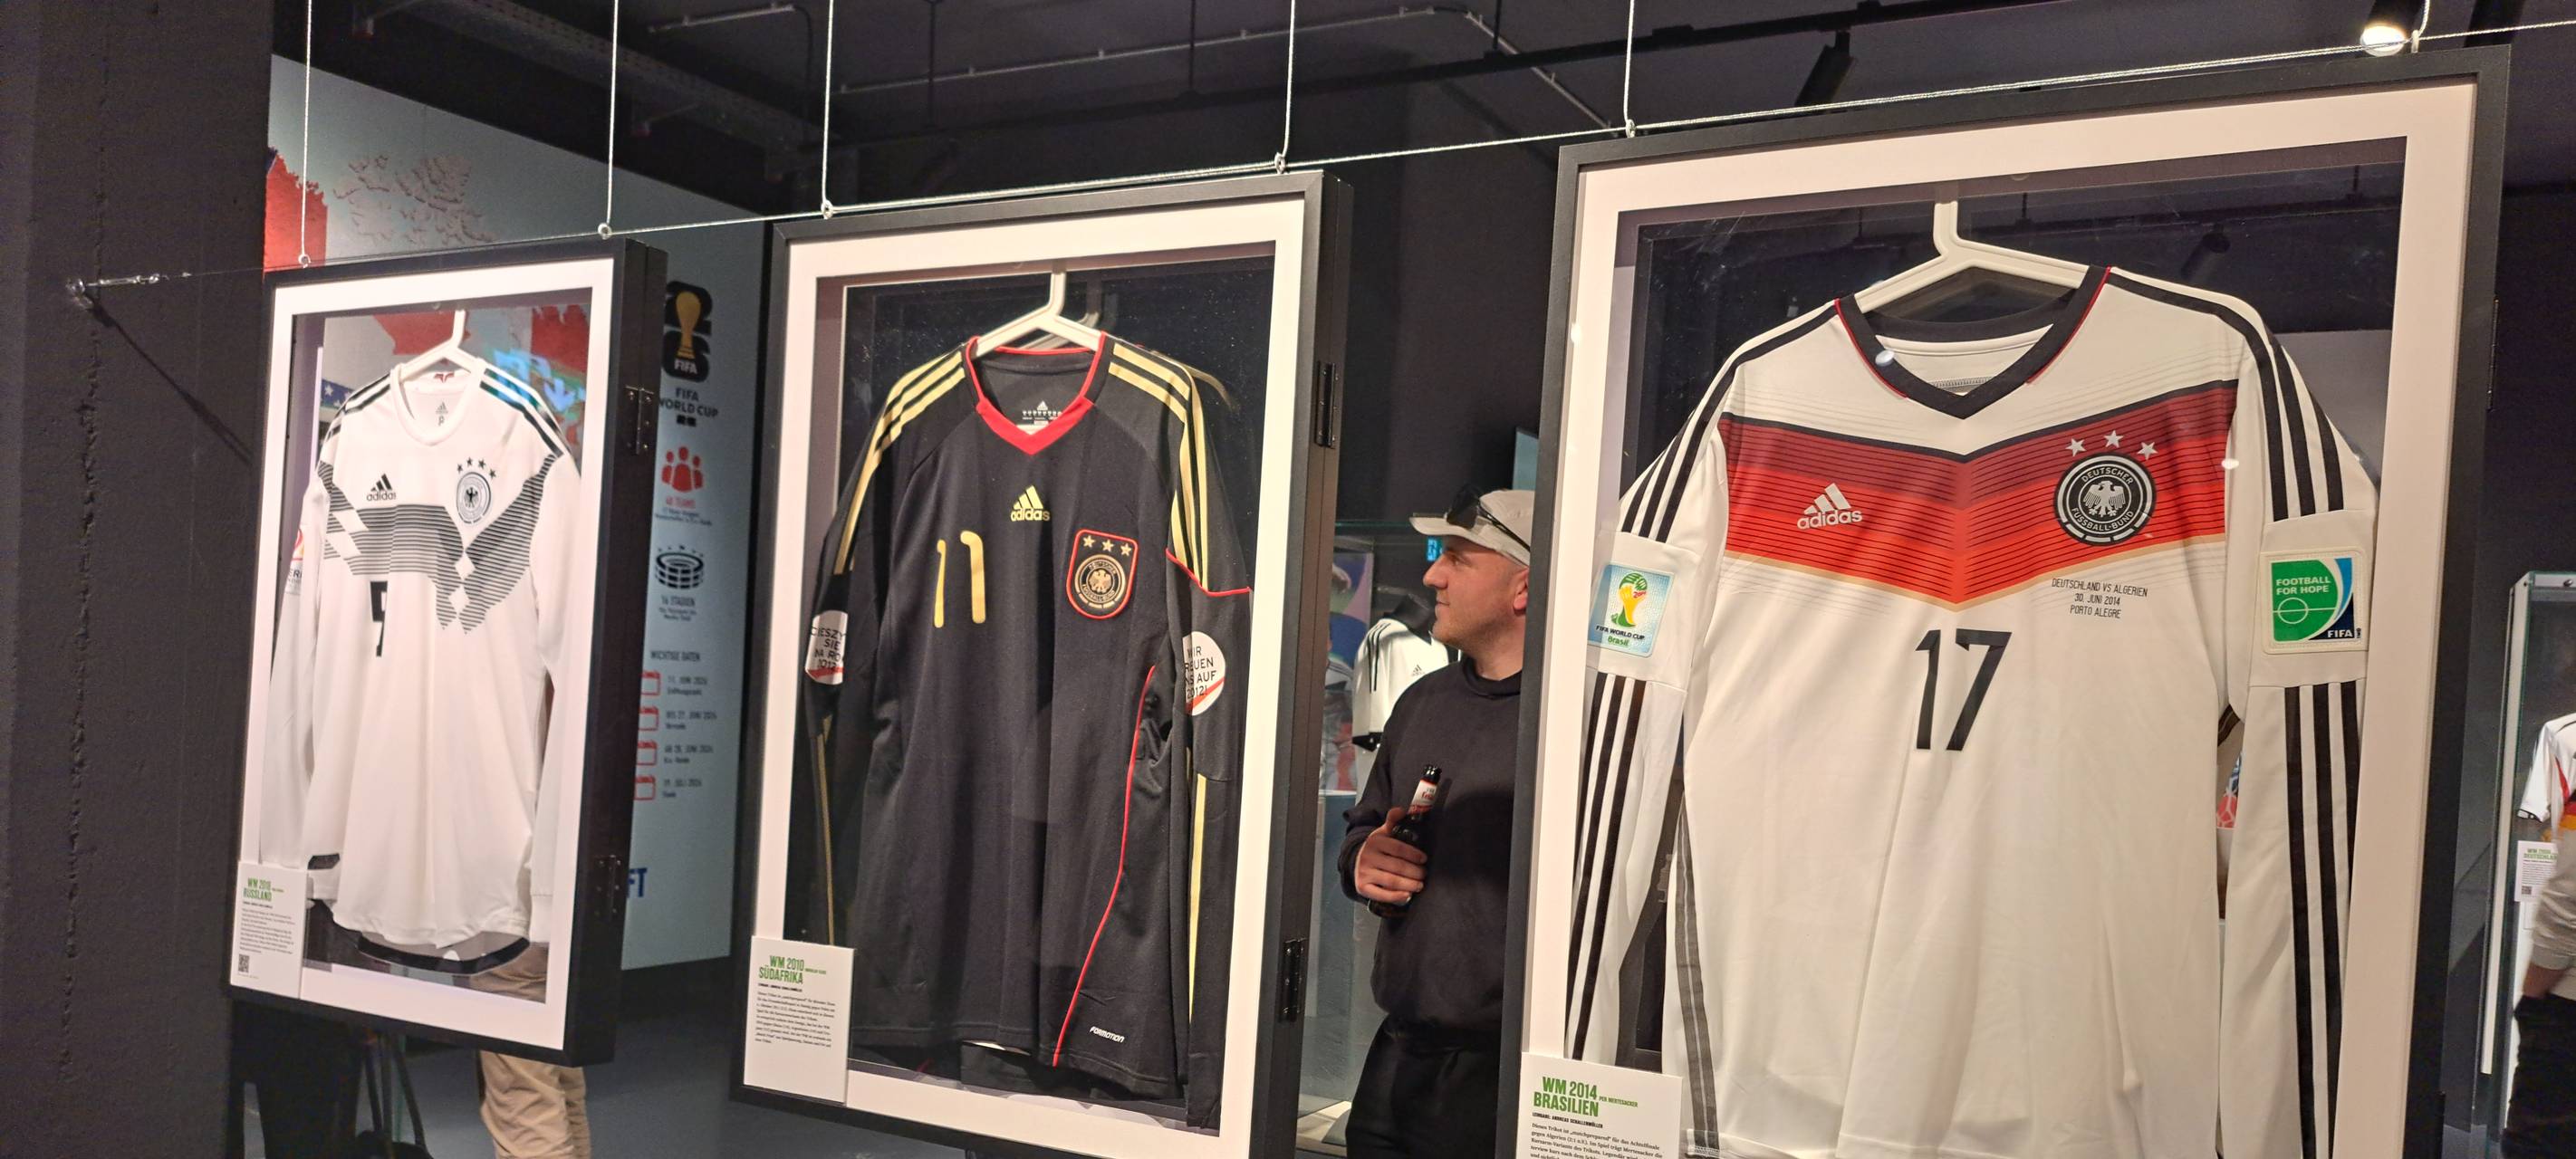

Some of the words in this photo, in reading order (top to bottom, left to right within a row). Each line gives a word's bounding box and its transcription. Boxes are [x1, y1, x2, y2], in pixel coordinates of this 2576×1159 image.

[674, 359, 697, 375] FIFA
[676, 388, 699, 402] FIFA
[697, 406, 718, 418] CUP
[2081, 467, 2134, 485] DEUTSCHER
[367, 491, 396, 502] adidas
[1011, 508, 1051, 522] adidas
[1797, 509, 1862, 529] adidas
[2052, 578, 2100, 592] DEUTSCHLAND
[2102, 583, 2111, 592] VS
[2113, 585, 2148, 598] ALGERIEN
[2275, 576, 2331, 587] FOOTBALL
[2276, 587, 2297, 596] FOR
[2301, 585, 2330, 594] HOPE
[2074, 593, 2085, 603] 30.
[2087, 594, 2102, 604] JUNI
[2104, 596, 2120, 606] 2014
[2070, 605, 2092, 616] PORTO
[2094, 608, 2121, 619] ALEGRE
[1596, 625, 1609, 633] FIFA
[1610, 628, 1632, 637] WORLD
[2327, 629, 2353, 638] FIFA
[1608, 636, 1629, 646] Brasil
[682, 651, 700, 662] DATEN
[1197, 670, 1216, 684] AUF
[1915, 628, 2013, 751] 17
[770, 955, 785, 968] WM
[787, 958, 804, 971] 2010
[759, 965, 803, 984] SÜDAFRIKA
[1543, 1077, 1566, 1095] WM
[1569, 1081, 1598, 1100] 2014
[1533, 1091, 1599, 1117] BRASILIEN
